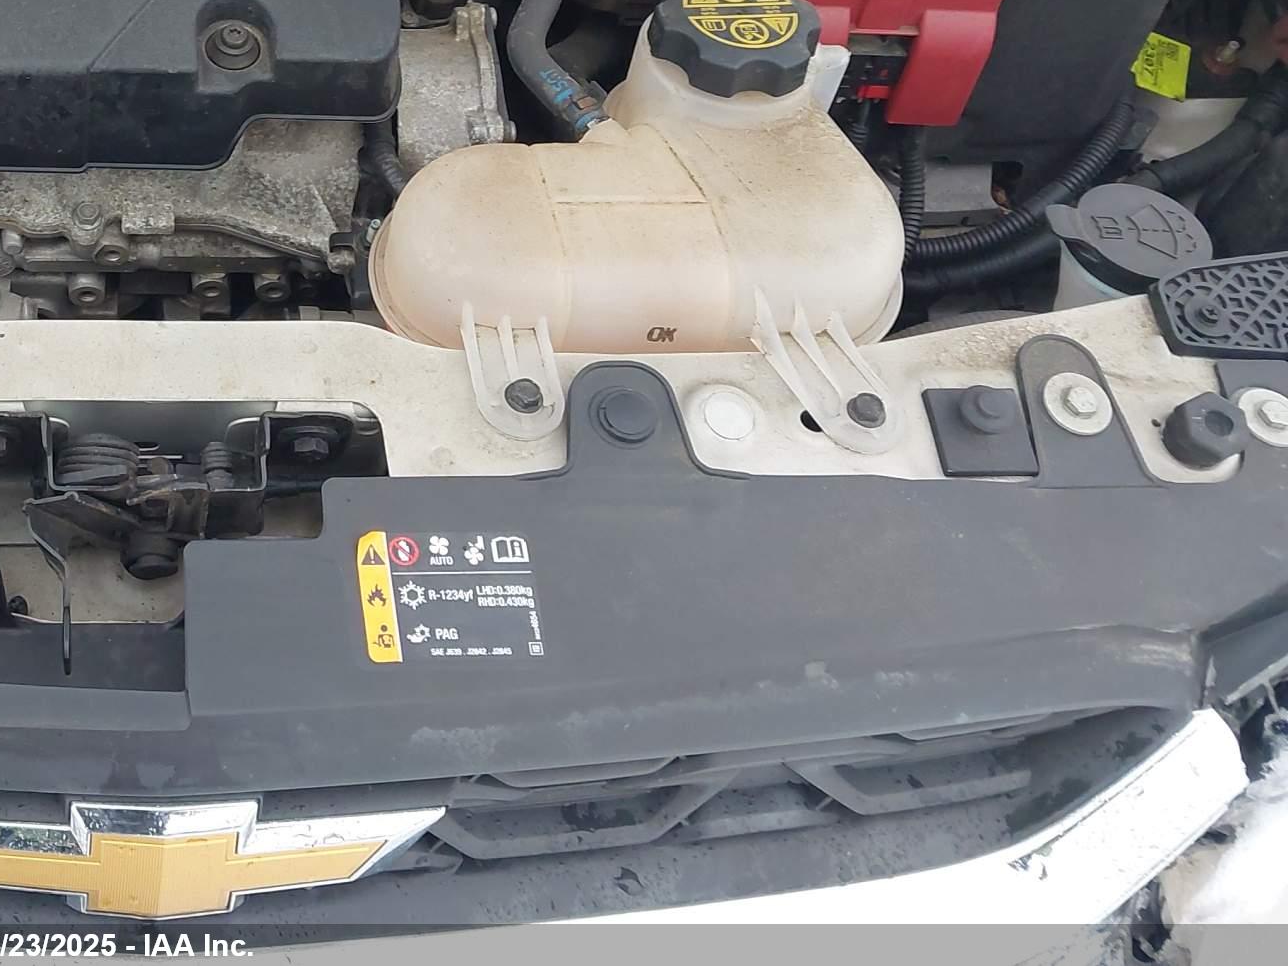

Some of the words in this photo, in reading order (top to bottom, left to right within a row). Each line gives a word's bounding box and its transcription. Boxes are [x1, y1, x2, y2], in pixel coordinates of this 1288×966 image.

[647, 326, 677, 343] OK
[429, 556, 454, 566] AUTO
[428, 589, 474, 603] R-1234yf
[435, 628, 459, 640] PAG
